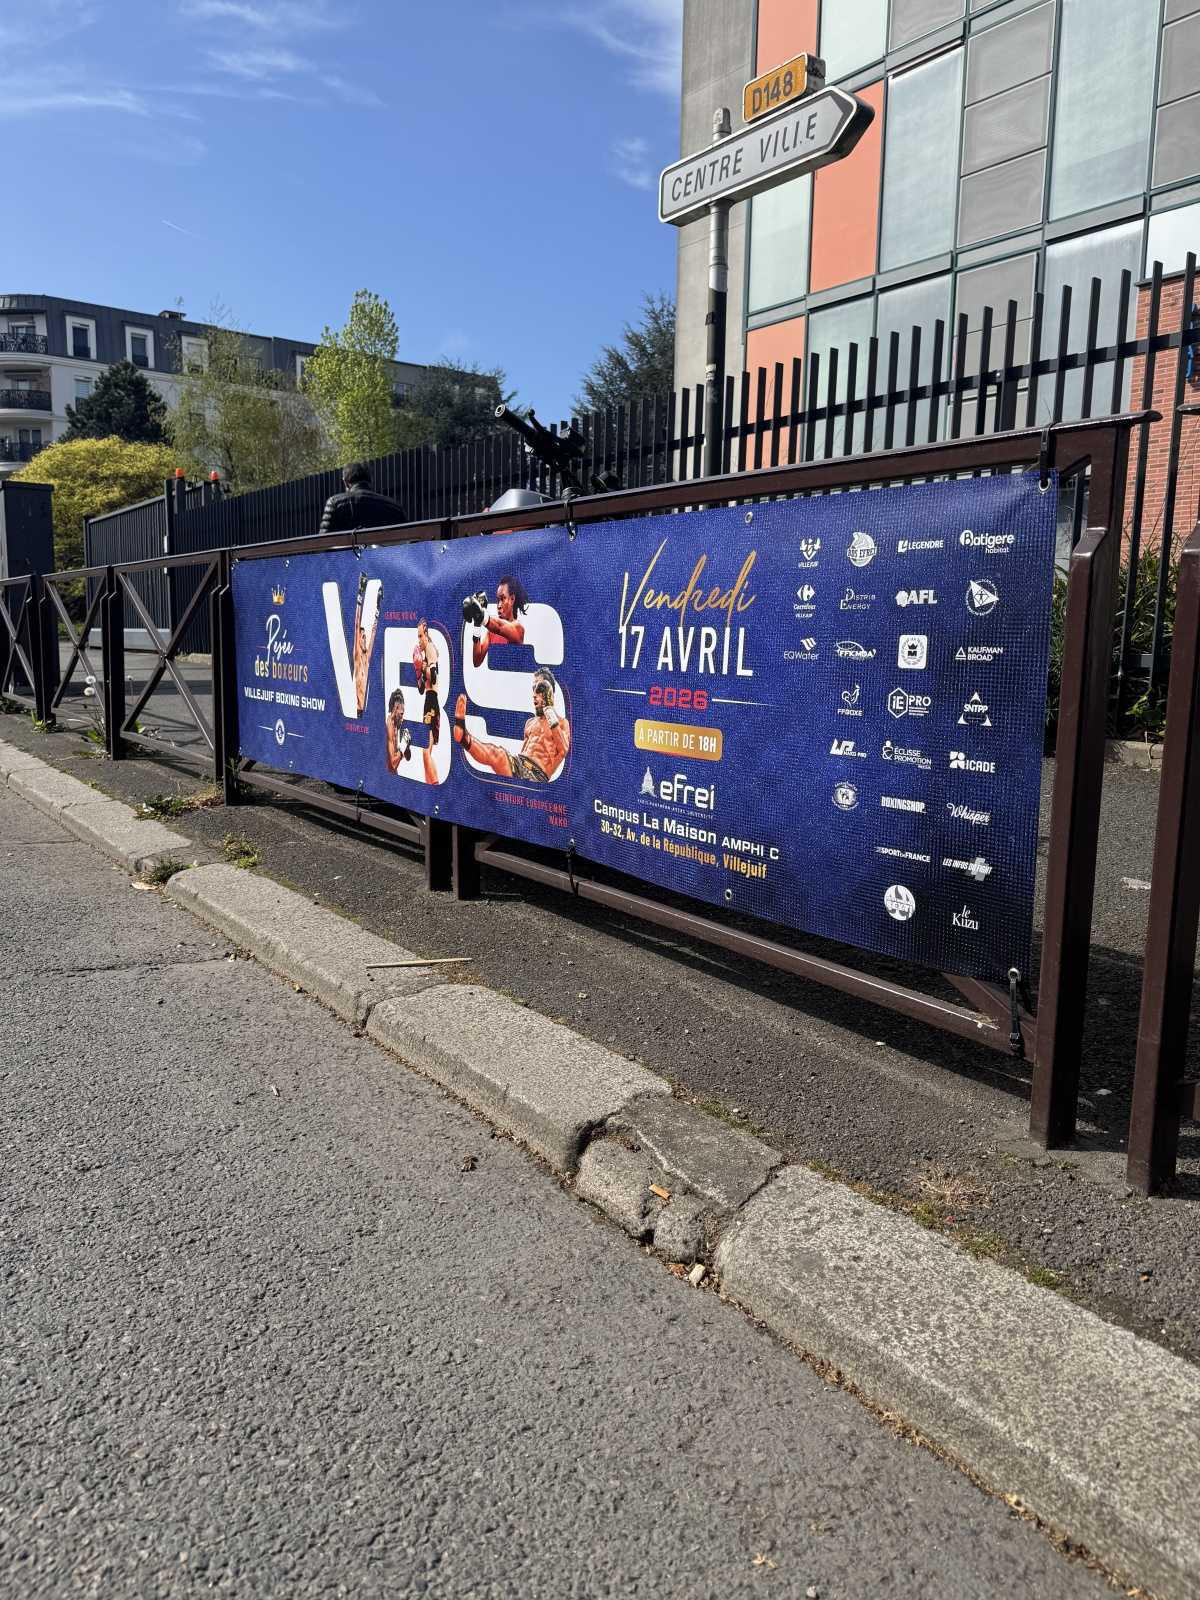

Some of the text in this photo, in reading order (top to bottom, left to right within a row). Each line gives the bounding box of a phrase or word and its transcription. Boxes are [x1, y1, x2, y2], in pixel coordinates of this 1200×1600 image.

[752, 71, 792, 113] D148
[672, 112, 817, 201] CENTRE VILLE
[908, 540, 943, 550] LEGENDRE
[620, 536, 757, 627] Vendredi
[908, 590, 937, 604] AFL
[619, 626, 753, 677] 17 AVRIL
[968, 653, 992, 661] BROAD
[255, 655, 308, 683] des boxeurs
[244, 686, 325, 711] VILLEJUIF BOXING SHOW
[649, 687, 709, 710] 2026
[909, 695, 931, 706] PRO
[963, 704, 988, 713] SNTPP
[647, 728, 679, 747] PARTIR
[682, 734, 695, 750] DE
[699, 736, 716, 752] 18H
[894, 755, 932, 765] PROMOTION
[965, 760, 996, 773] ICADE
[660, 774, 715, 810] efrei
[946, 802, 990, 826] Whisper
[594, 799, 780, 860] Campus La Maison AMPHI C
[600, 820, 767, 879] 30-32, Av. de la République, Villejuif
[943, 857, 953, 867] LES
[952, 859, 969, 870] INFOS
[952, 912, 979, 930] Kuzu
[961, 905, 971, 918] le
